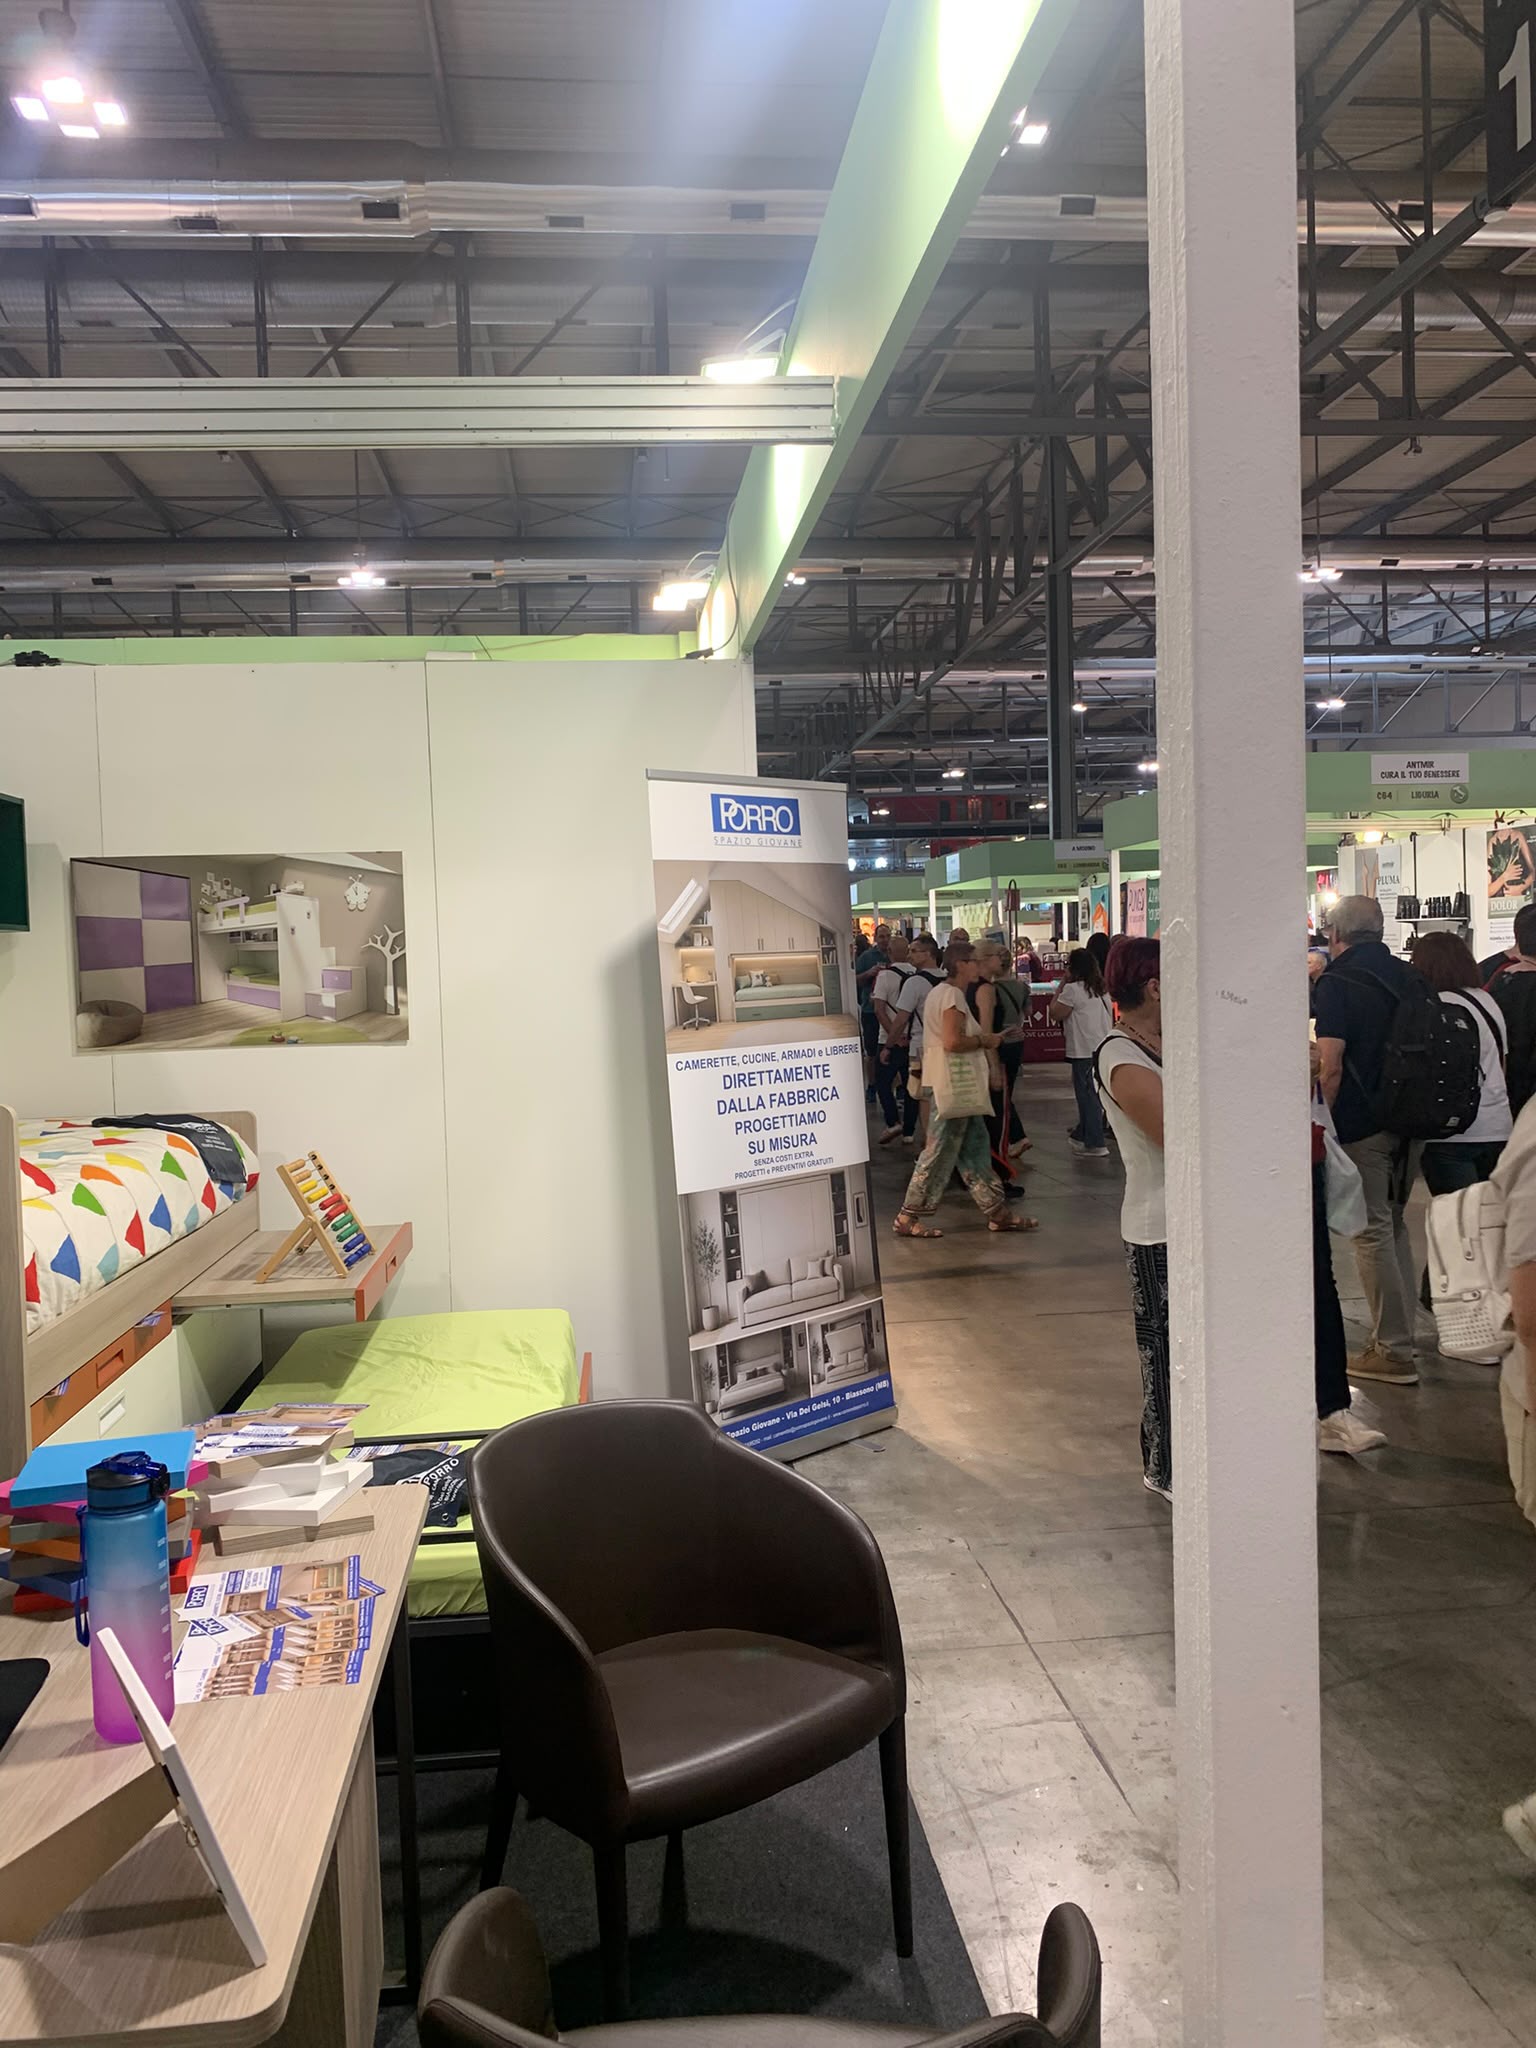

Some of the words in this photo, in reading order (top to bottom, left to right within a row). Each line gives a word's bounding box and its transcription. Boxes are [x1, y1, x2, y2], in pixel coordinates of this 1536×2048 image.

[1498, 20, 1532, 152] 1
[1380, 771, 1399, 779] CURA
[1408, 770, 1422, 778] TUO
[1424, 770, 1460, 778] BENESSERE
[1406, 760, 1434, 768] ANTMIR
[1411, 791, 1440, 799] LIGURIA
[720, 797, 794, 833] PORRO
[714, 836, 752, 846] SPAZIO
[758, 837, 802, 848] GIOVANE
[1378, 875, 1400, 885] PLUMA
[676, 1055, 740, 1072] CAMERETTE,
[742, 1050, 780, 1066] CUCINE,
[781, 1048, 816, 1061] ARMADI
[818, 1049, 823, 1057] e
[825, 1043, 859, 1056] LIBRERIE
[722, 1064, 831, 1090] DIRETTAMENTE
[717, 1094, 766, 1116] DALLA
[770, 1086, 840, 1108] FABBRICA
[735, 1110, 827, 1135] PROGETTIAMO
[748, 1140, 765, 1155] SU
[769, 1132, 817, 1152] MISURA
[735, 1168, 766, 1180] PROGETTI
[772, 1162, 806, 1174] PREVENTIVI
[807, 1157, 833, 1168] GRATUITI
[754, 1157, 774, 1167] SENZA
[775, 1154, 794, 1163] COSTI
[794, 1151, 814, 1161] EXTRA
[752, 1417, 780, 1432] Giovane
[786, 1410, 798, 1420] Via
[799, 1406, 811, 1417] Dei
[812, 1401, 831, 1415] Gelsi,
[832, 1396, 840, 1405] 10
[845, 1384, 874, 1401] Biassono
[875, 1379, 889, 1392] (MB)
[424, 1458, 459, 1486] PORRO
